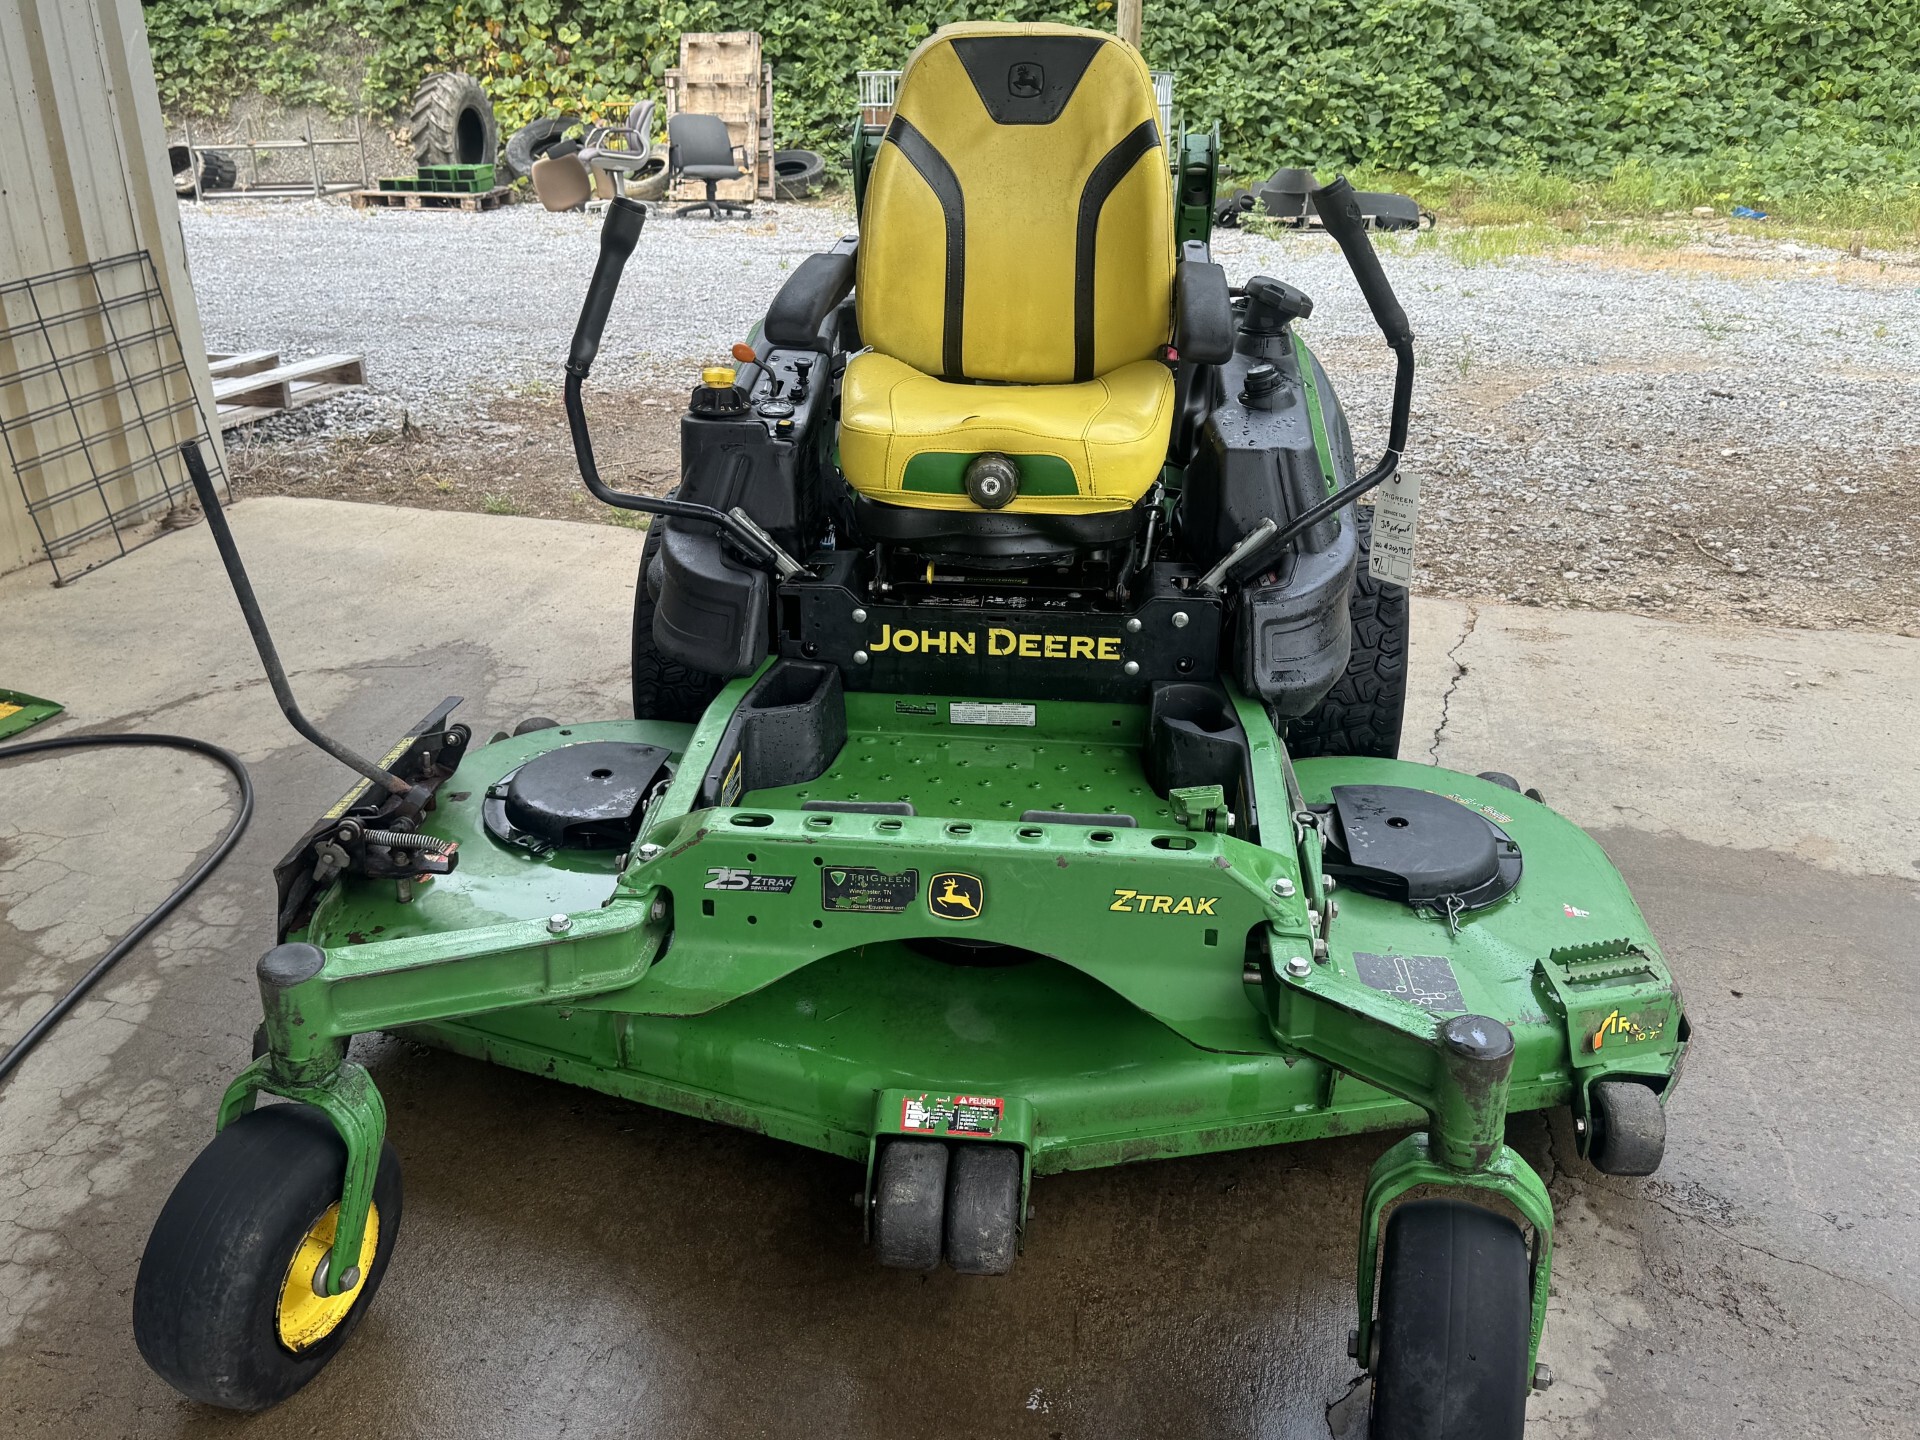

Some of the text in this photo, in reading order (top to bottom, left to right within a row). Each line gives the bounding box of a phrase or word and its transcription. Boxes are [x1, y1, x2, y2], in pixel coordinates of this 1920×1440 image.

[1381, 491, 1414, 505] TRIGREEN
[869, 624, 1122, 660] JOHN DEERE
[704, 868, 793, 890] 25 ZTRAK
[849, 873, 911, 883] TRIGREEN
[1110, 889, 1219, 915] ZTRAK
[968, 1097, 997, 1106] PELIGRO
